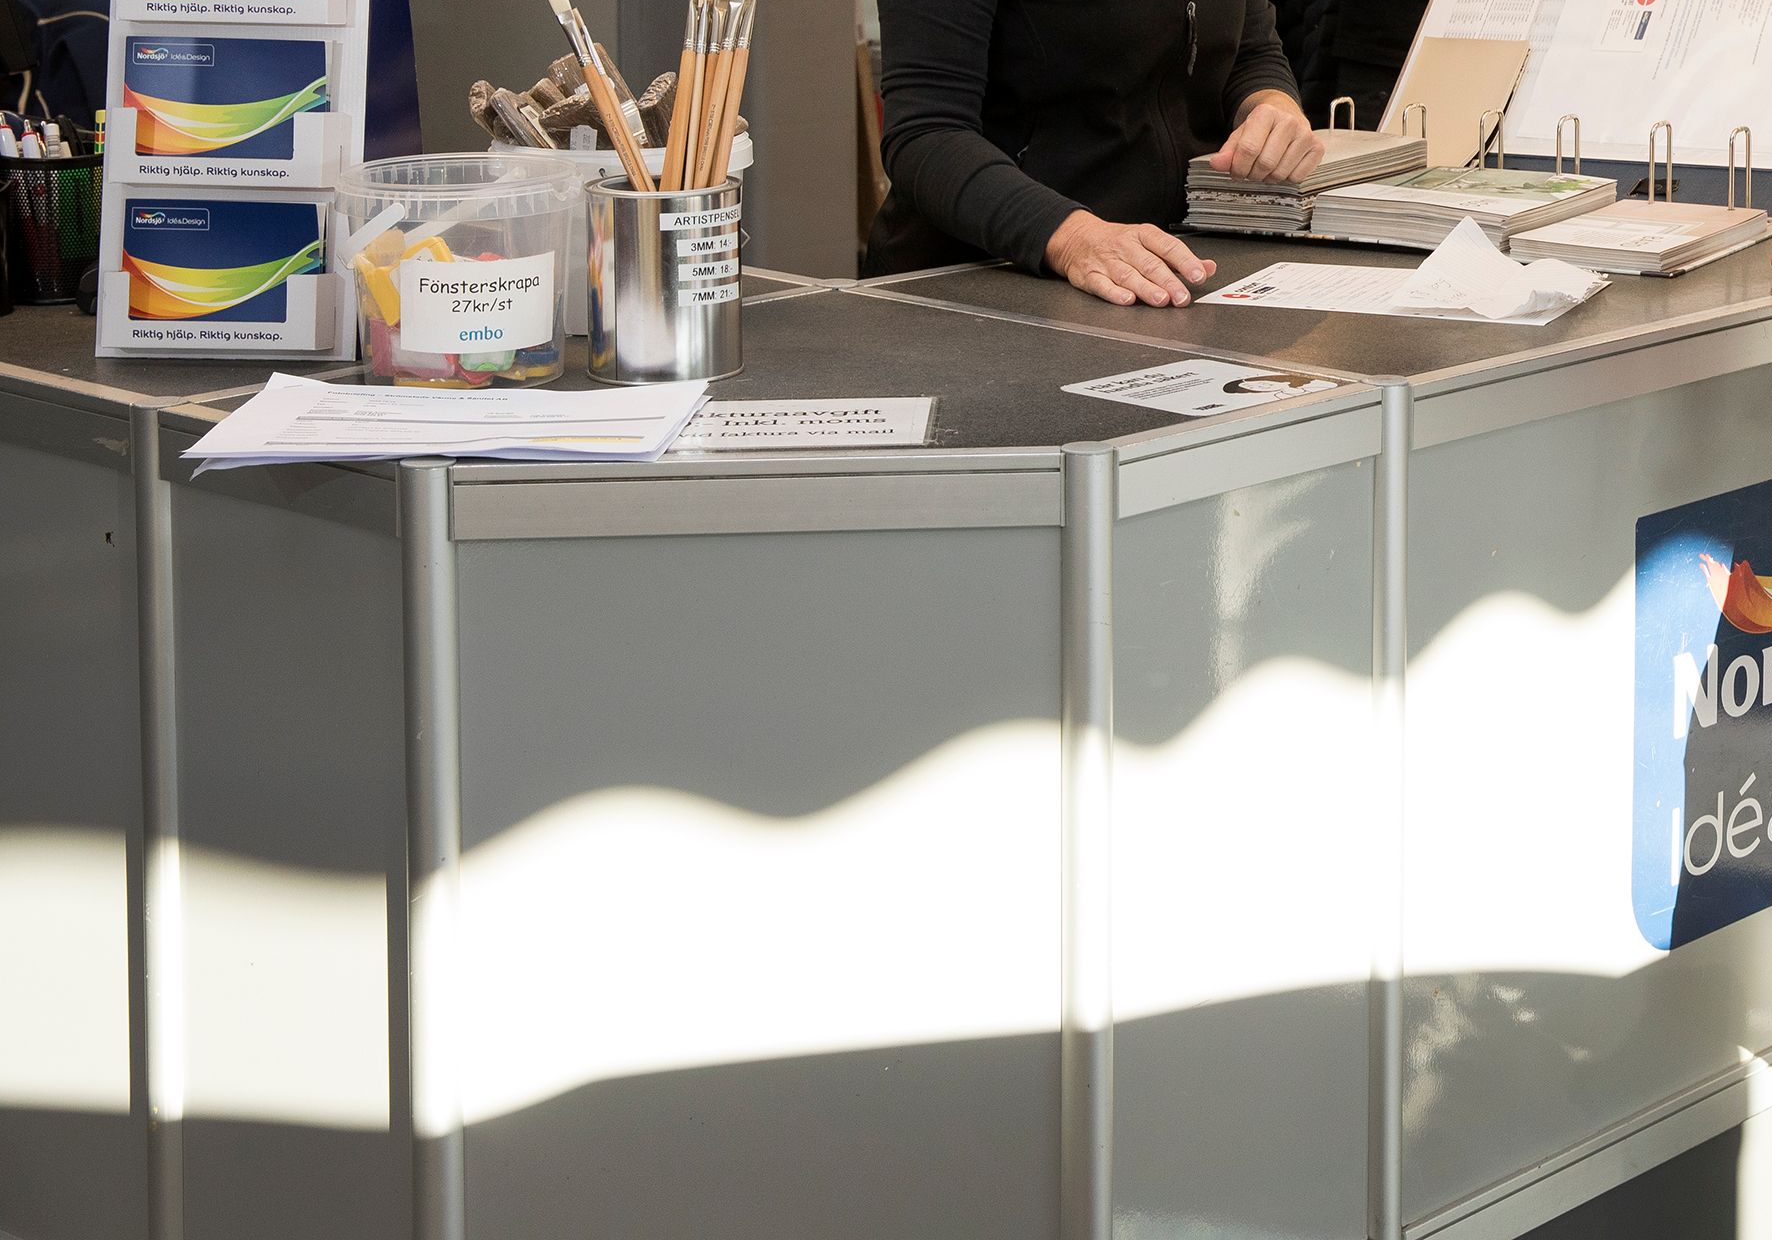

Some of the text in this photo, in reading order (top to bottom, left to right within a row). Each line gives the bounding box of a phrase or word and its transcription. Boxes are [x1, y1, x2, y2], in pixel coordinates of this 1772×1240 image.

[146, 2, 297, 15] Riktig hjälp. Riktig kunskap.
[137, 51, 211, 62] Nordsjö Idé&Design
[139, 164, 290, 178] Riktig hjälp. Riktig kunskap.
[135, 215, 206, 226] Nordsjö Idé&Design
[674, 208, 740, 226] ARTISTPENSEL
[690, 239, 732, 252] 3MM: 14:-
[692, 264, 733, 277] 5MM: 18:-
[419, 275, 540, 294] Fönsterskrapa
[692, 289, 733, 302] 7MM: 21:-
[451, 298, 513, 314] 27kr/st
[132, 328, 283, 342] Riktig hjälp. Riktig kunskap.
[459, 326, 504, 342] embo
[693, 408, 881, 418] akturaavgift
[799, 417, 887, 425] moms
[720, 430, 798, 438] faktura
